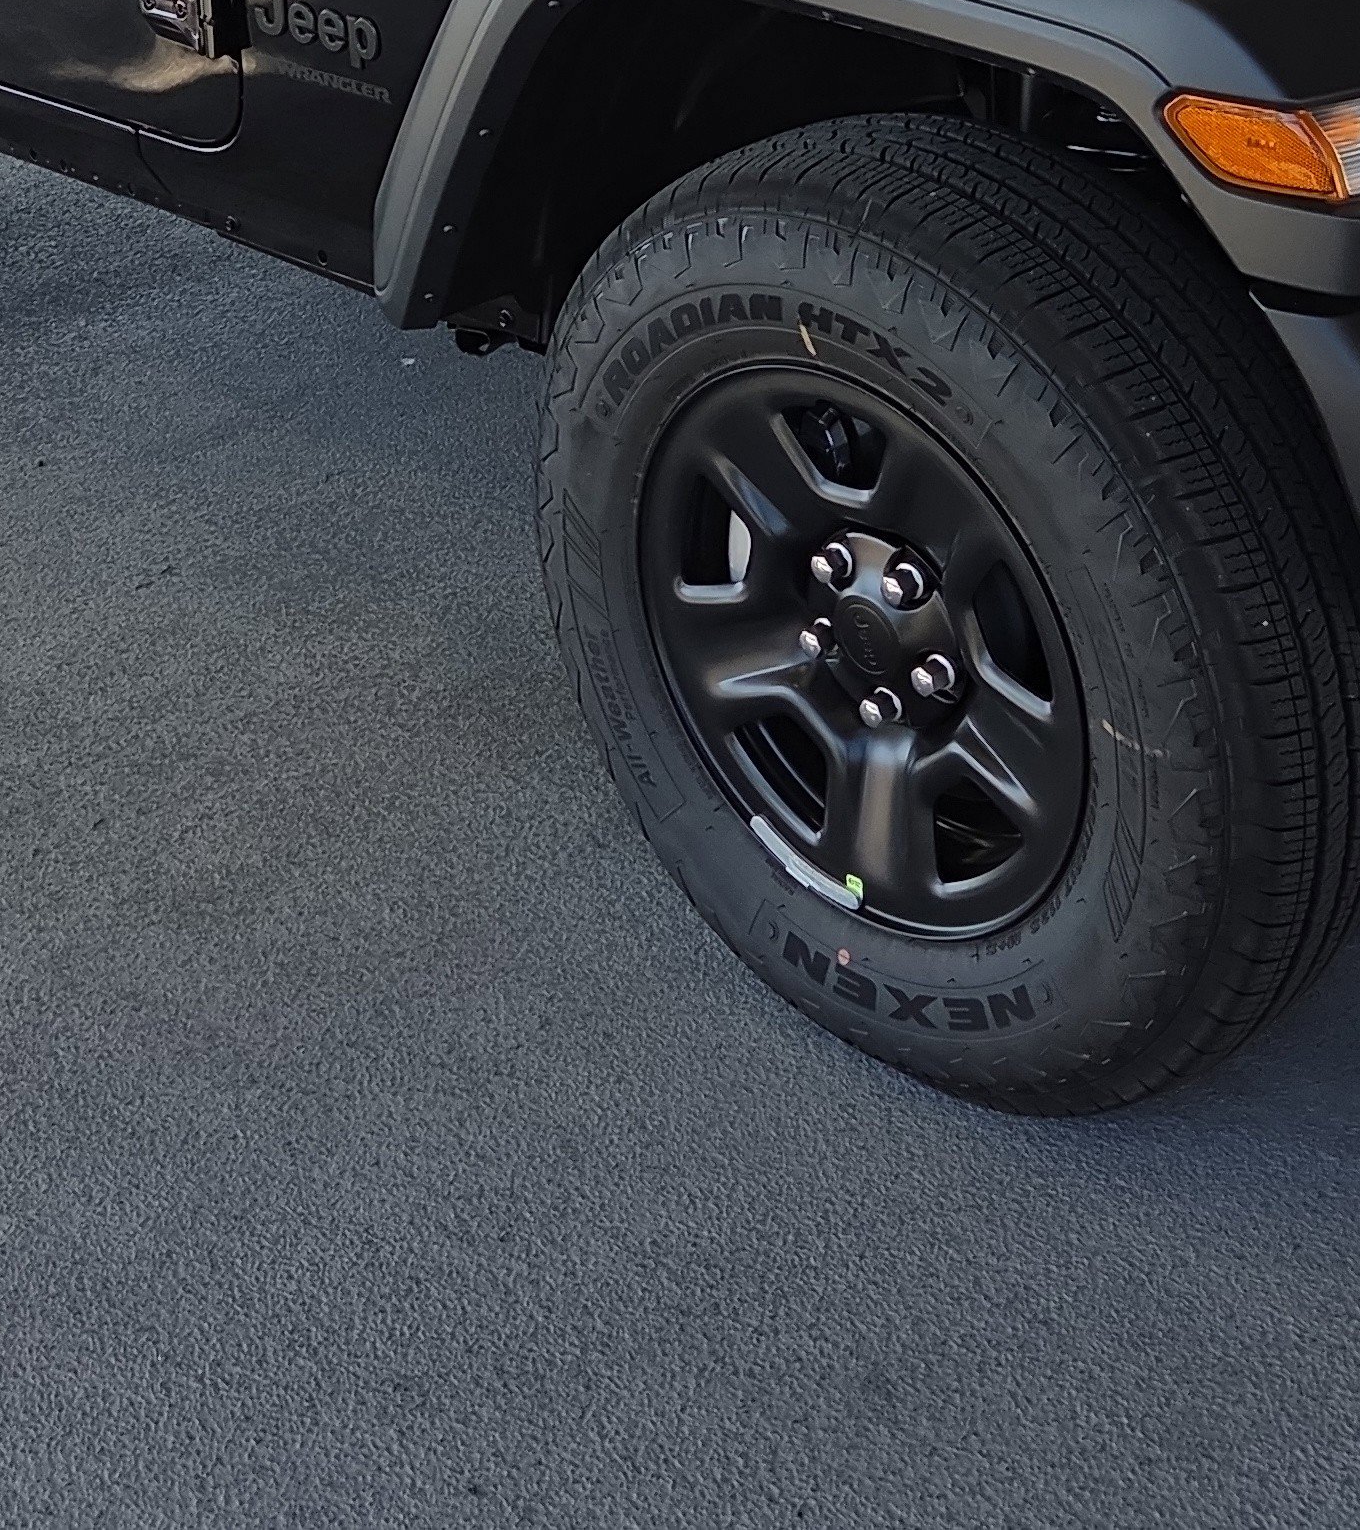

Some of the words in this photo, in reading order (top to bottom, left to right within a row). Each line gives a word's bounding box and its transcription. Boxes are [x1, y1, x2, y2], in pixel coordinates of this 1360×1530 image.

[277, 57, 393, 106] WRANGLER
[601, 293, 785, 405] ROADIAN
[583, 624, 657, 788] All-Weather
[781, 929, 1038, 1033] NEXEN
